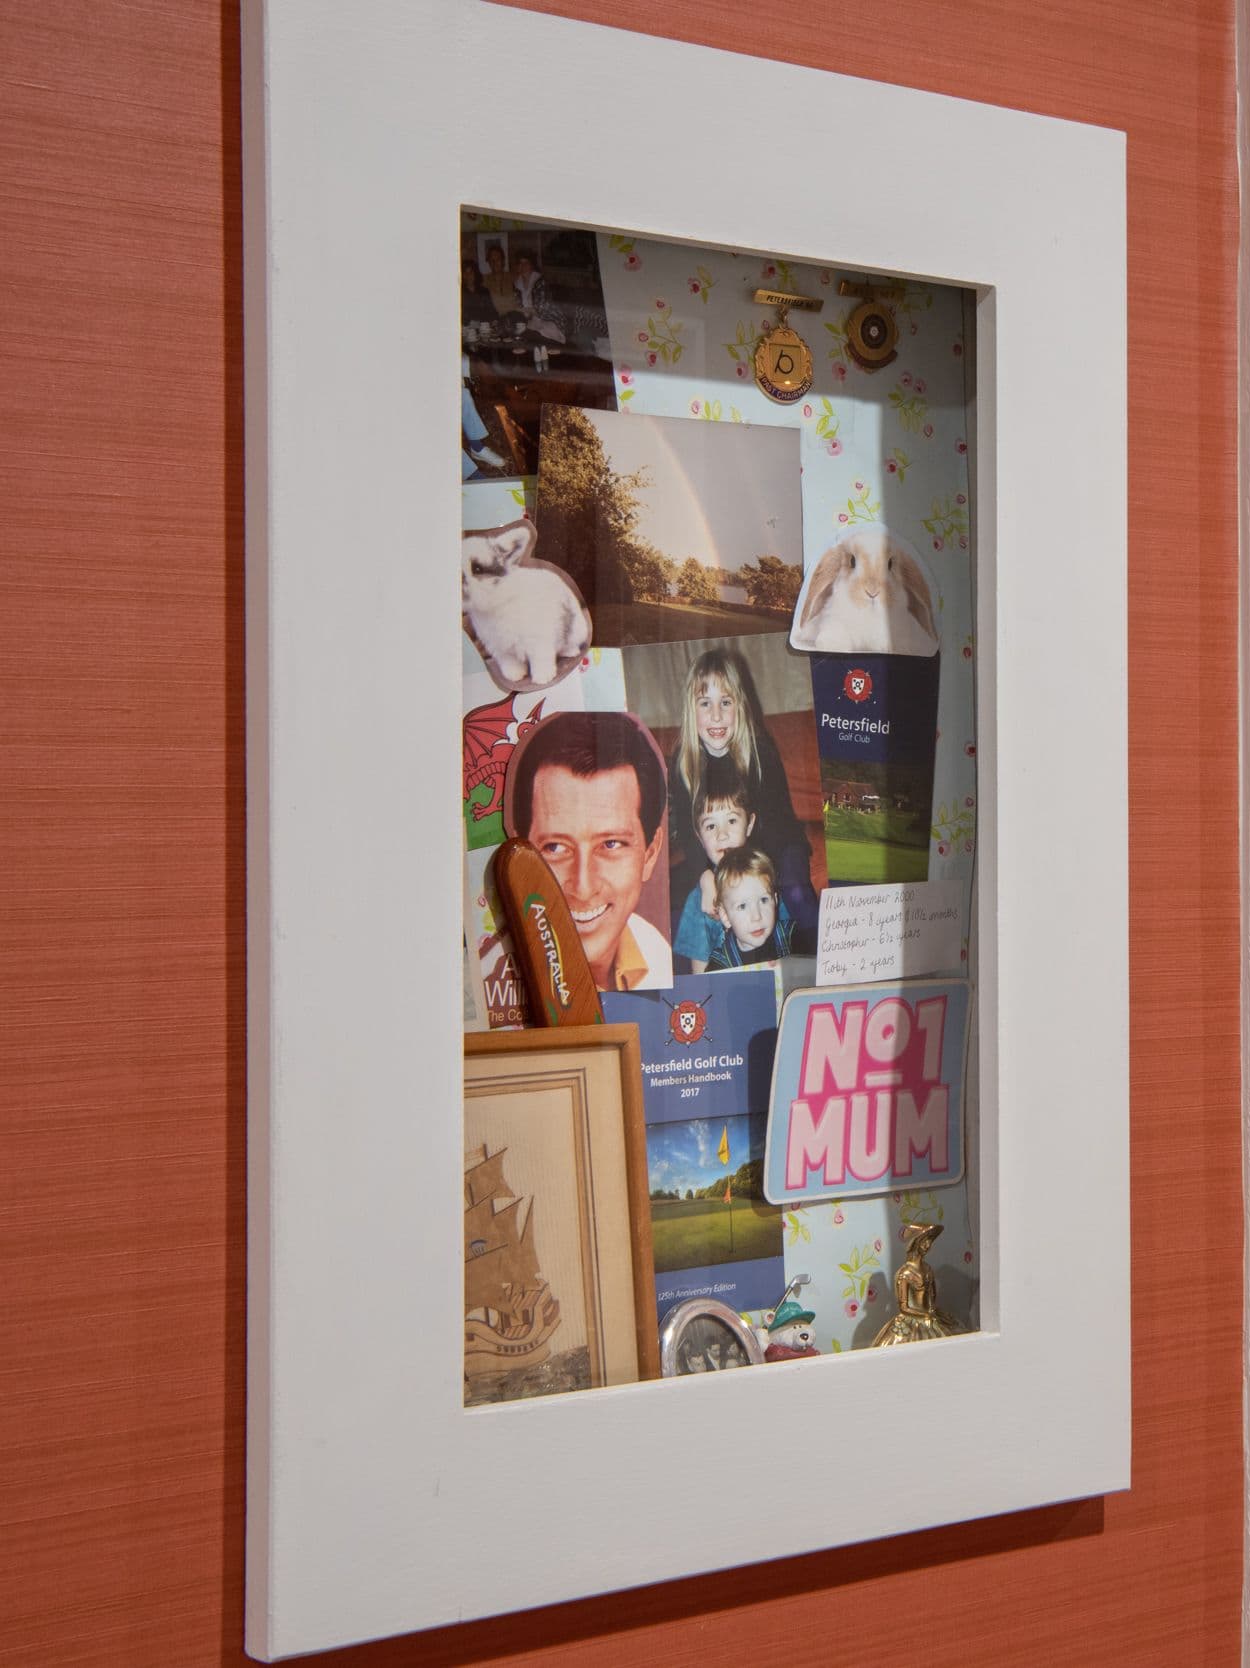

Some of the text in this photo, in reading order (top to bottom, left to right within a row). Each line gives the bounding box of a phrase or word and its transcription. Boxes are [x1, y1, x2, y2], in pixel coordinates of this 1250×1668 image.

[821, 712, 890, 735] Petersfield
[838, 732, 871, 744] Golf Club
[848, 891, 889, 908] November
[530, 903, 571, 1006] AUSTRALIA
[694, 1056, 718, 1069] Golf
[719, 1054, 744, 1067] Club
[650, 1070, 732, 1087] Members Handbook
[680, 1087, 700, 1098] 2017
[785, 1084, 948, 1190] MUM
[675, 1286, 713, 1298] Anniversary
[713, 1282, 736, 1293] Edition
